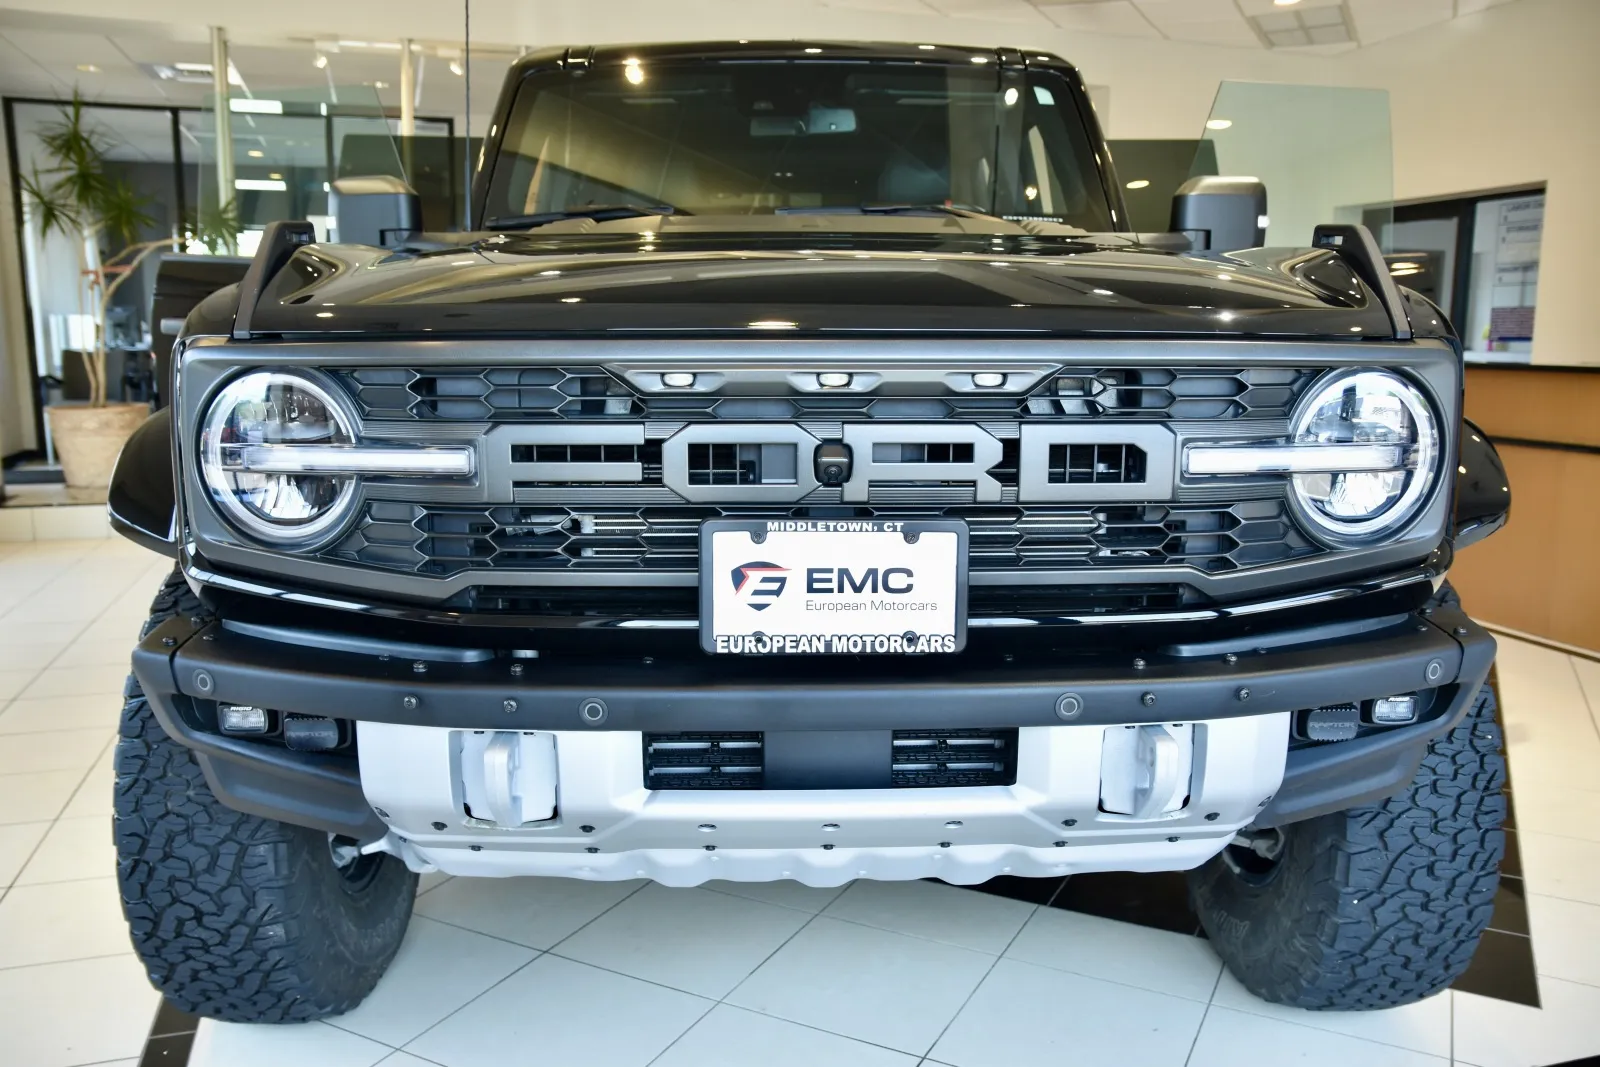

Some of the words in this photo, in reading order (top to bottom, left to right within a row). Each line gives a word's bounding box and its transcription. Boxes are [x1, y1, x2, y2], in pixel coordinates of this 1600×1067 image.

[483, 424, 1175, 503] FORD
[766, 521, 878, 532] MIDDLETOWN,
[883, 522, 903, 532] CT
[806, 567, 914, 594] EMC
[805, 600, 867, 613] European
[871, 600, 937, 611] Motorcars
[716, 635, 825, 653] EUROPEAN
[832, 635, 956, 653] MOTORCARS
[1310, 721, 1355, 729] RAPTOR
